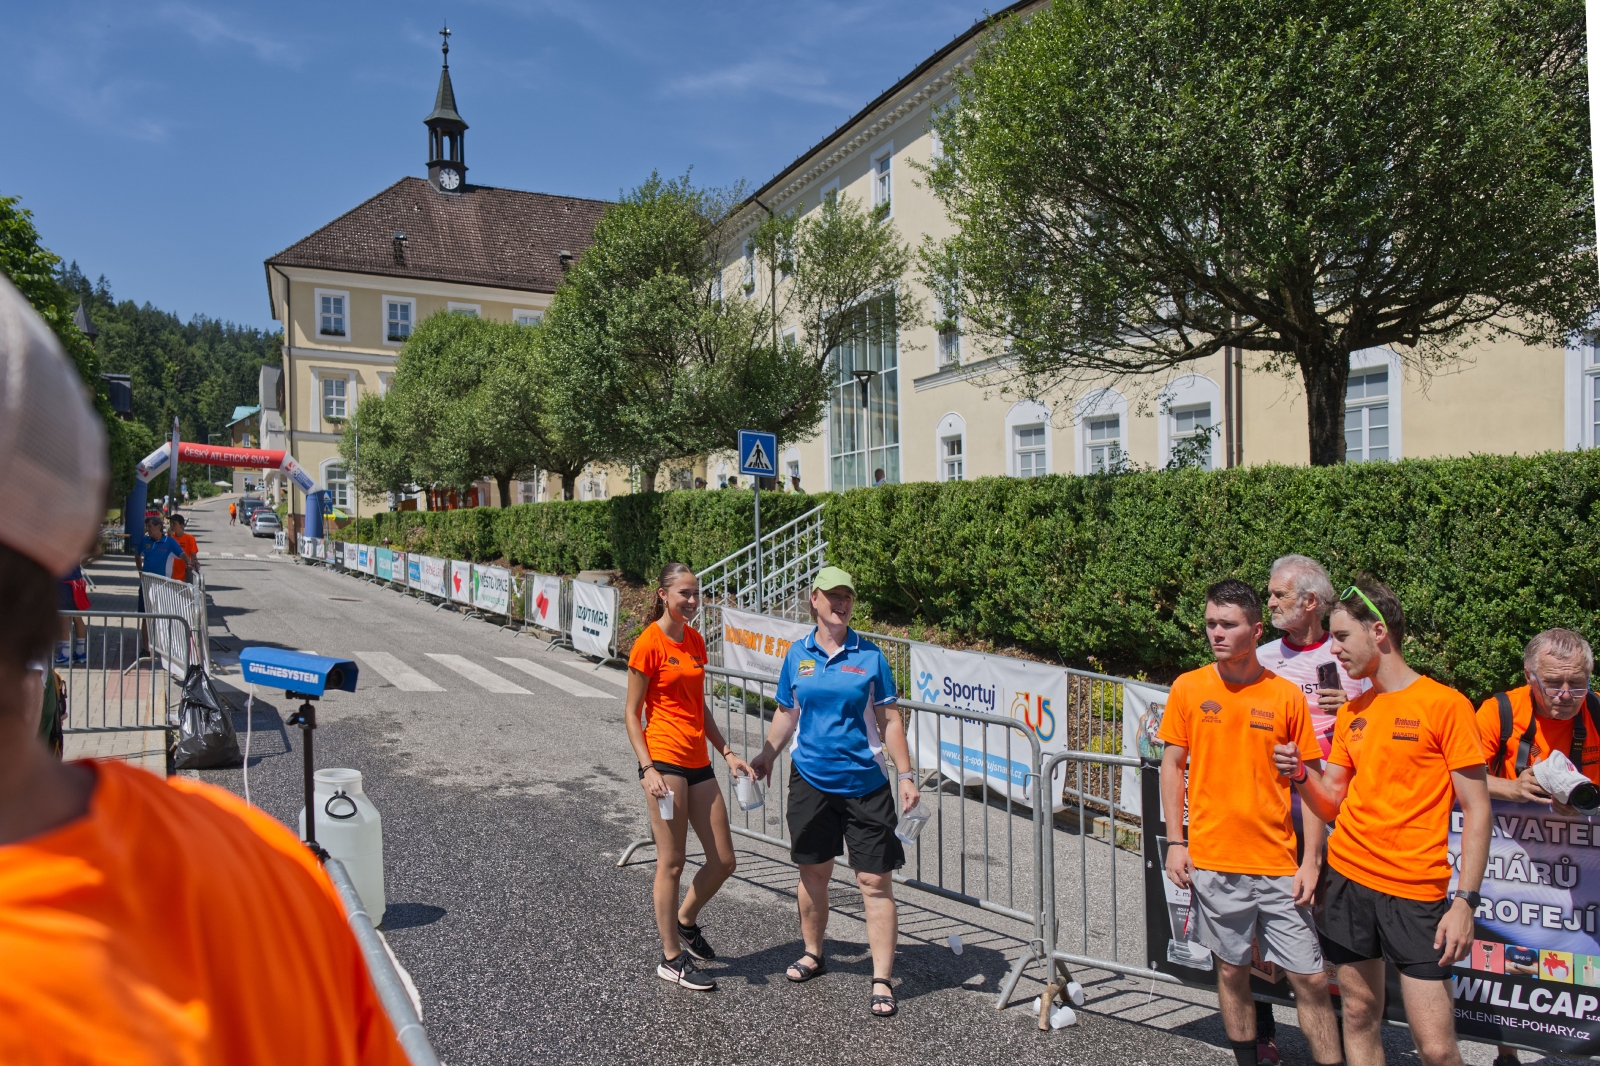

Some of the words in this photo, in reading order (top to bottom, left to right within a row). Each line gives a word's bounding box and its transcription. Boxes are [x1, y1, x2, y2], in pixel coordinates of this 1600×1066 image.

[184, 447, 209, 458] ČESKÝ
[210, 452, 249, 463] ATLETICKÝ
[251, 456, 270, 465] SVAZ
[764, 635, 775, 656] SE
[249, 662, 319, 684] ONLINESYSTEM
[943, 676, 995, 710] Sportuj
[1451, 811, 1600, 848] DVATE
[1451, 893, 1597, 933] ROFEJÍ
[1452, 975, 1598, 1020] WILLCAP
[1453, 1008, 1591, 1040] SKLENENE-POHARY.cz
